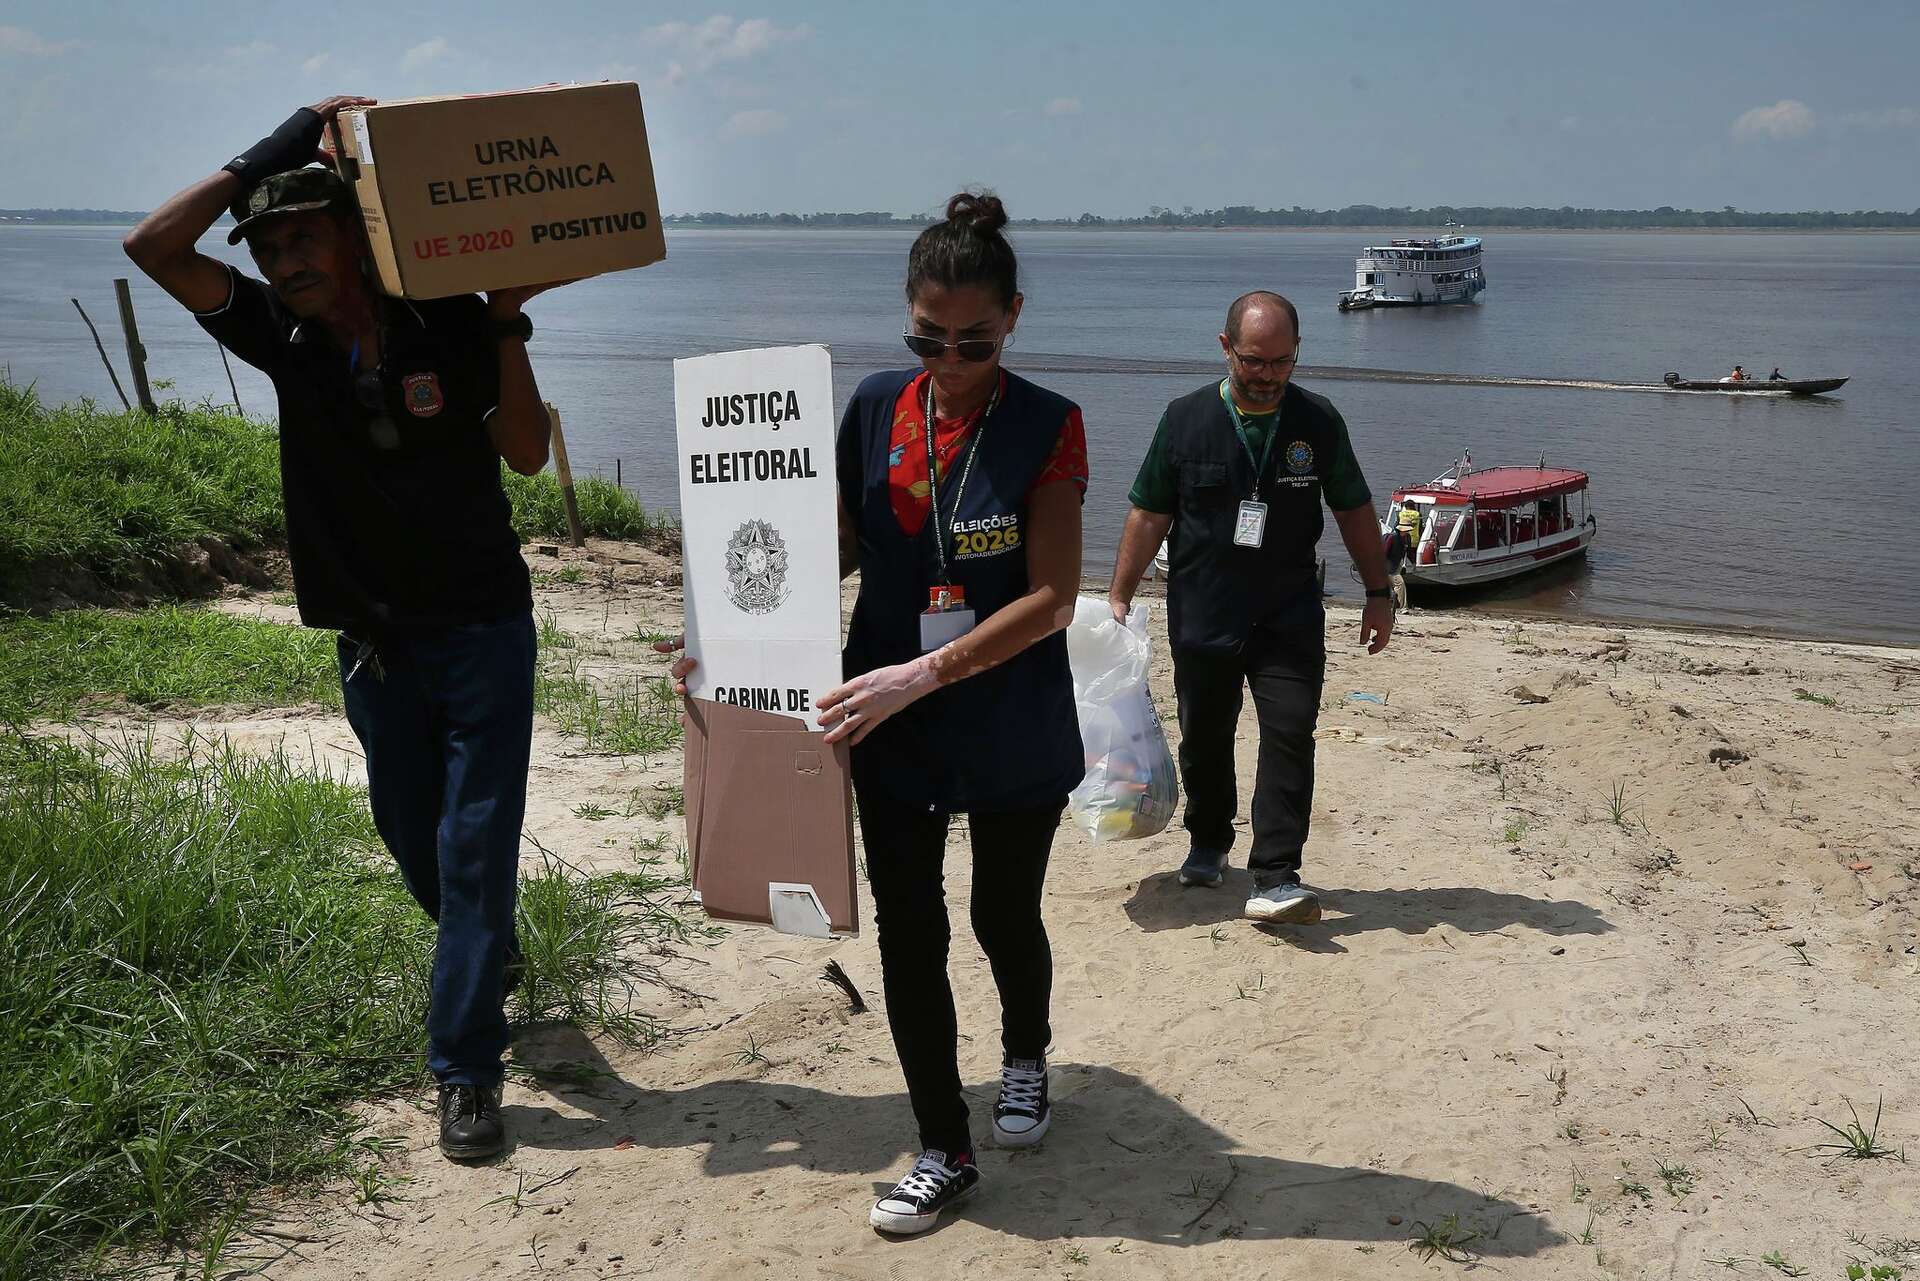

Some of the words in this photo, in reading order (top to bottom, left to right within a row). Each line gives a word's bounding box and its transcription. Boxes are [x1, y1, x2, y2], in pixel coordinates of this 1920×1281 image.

[475, 135, 559, 164] URNA
[429, 163, 614, 205] ELETRÔNICA
[415, 236, 451, 260] UE
[459, 229, 514, 254] 2020
[532, 211, 647, 244] POSITIVO
[702, 390, 799, 431] JUSTIÇA
[691, 448, 817, 484] ELEITORAL
[953, 514, 1018, 533] ELEIÇÕES
[956, 527, 1019, 554] 2026
[715, 687, 782, 711] CABINA
[787, 689, 809, 712] DE
